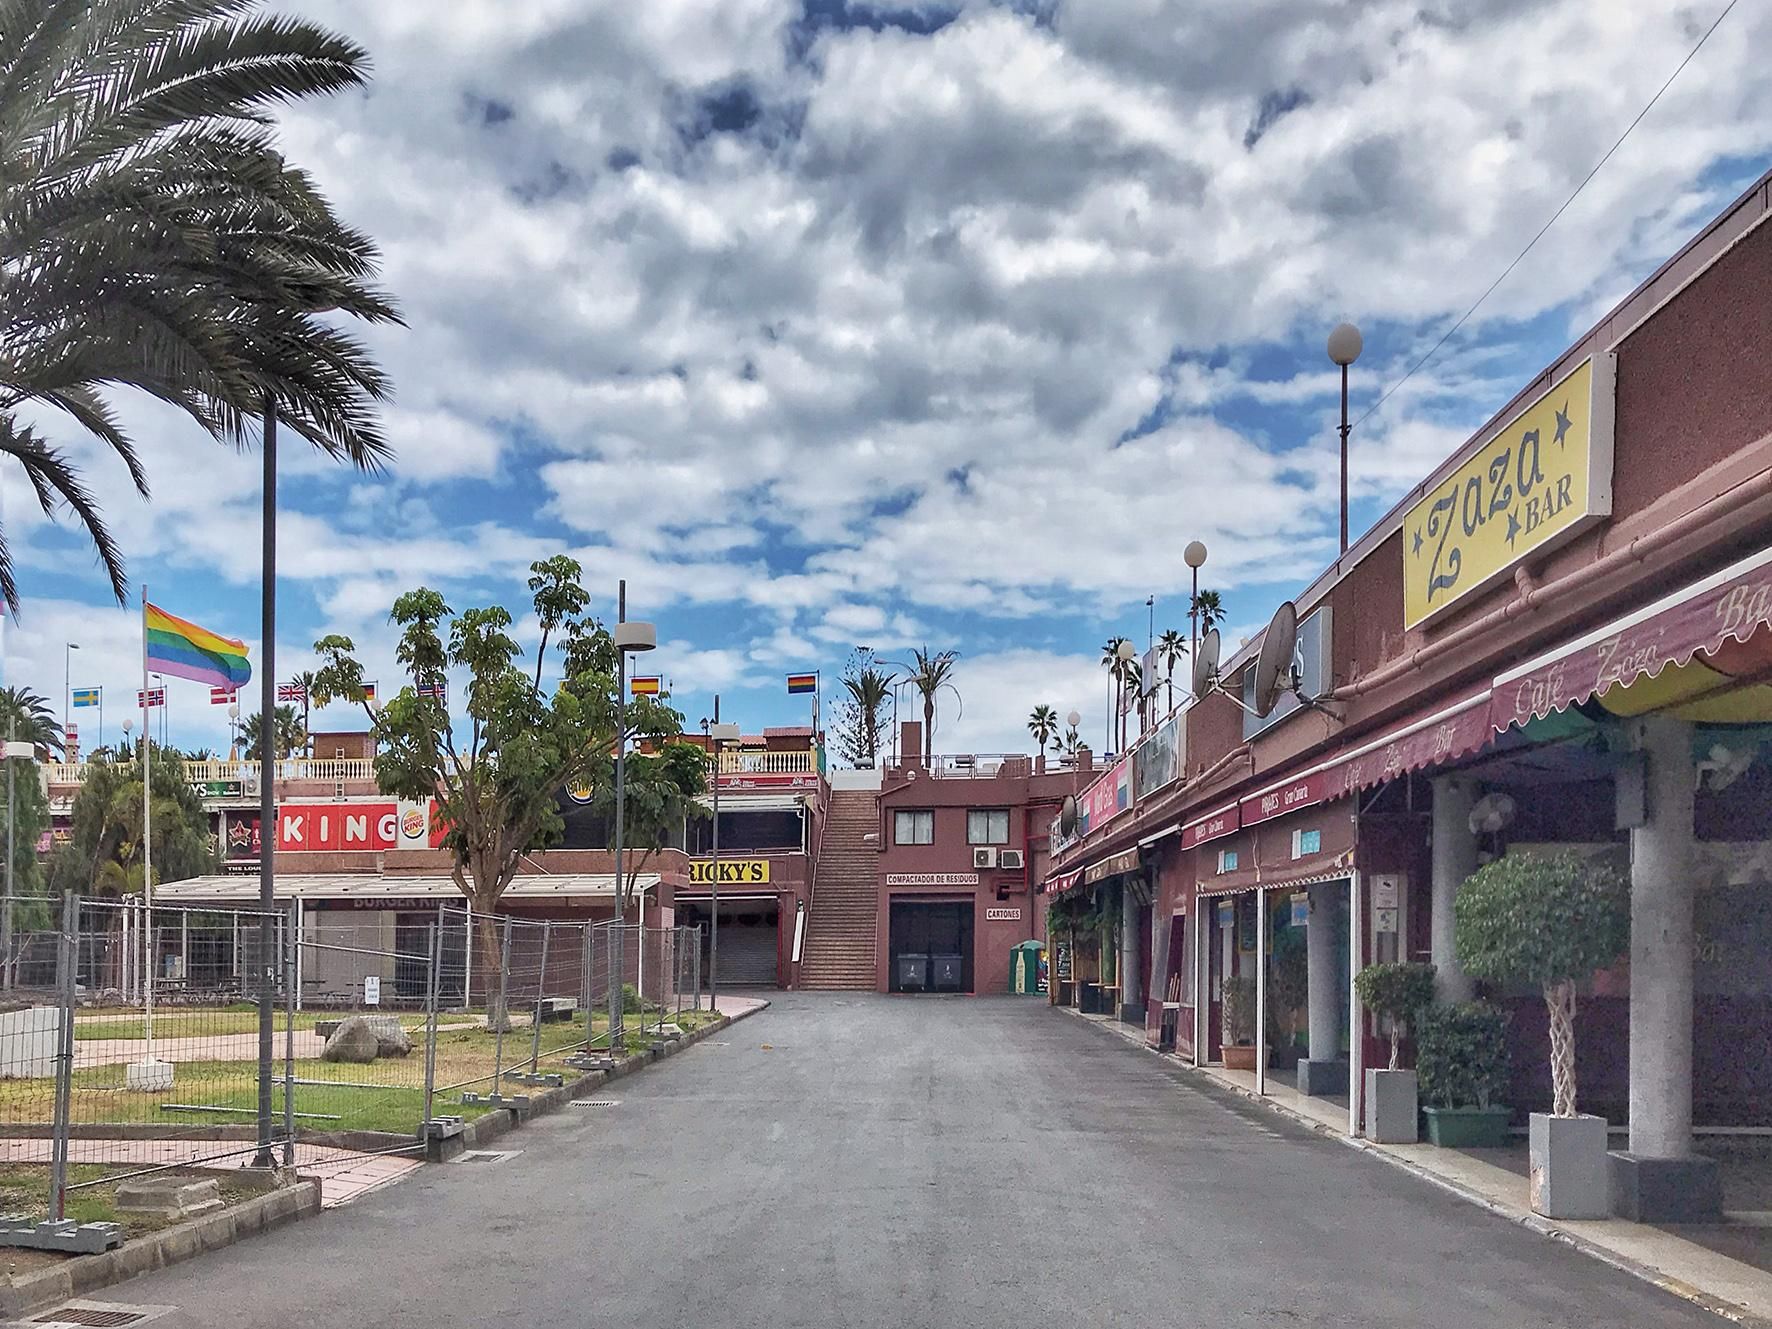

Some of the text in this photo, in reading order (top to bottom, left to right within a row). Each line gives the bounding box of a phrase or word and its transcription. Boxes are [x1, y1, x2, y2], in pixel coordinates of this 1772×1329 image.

[1427, 428, 1545, 604] Zaza
[1524, 474, 1574, 536] BAR
[1515, 661, 1567, 717] Café
[1716, 584, 1772, 636] Ba
[283, 814, 396, 842] KING
[404, 821, 424, 833] KING
[889, 874, 978, 884] COMPACTADOR DE RESIDUOS
[987, 910, 1020, 920] CARTONES
